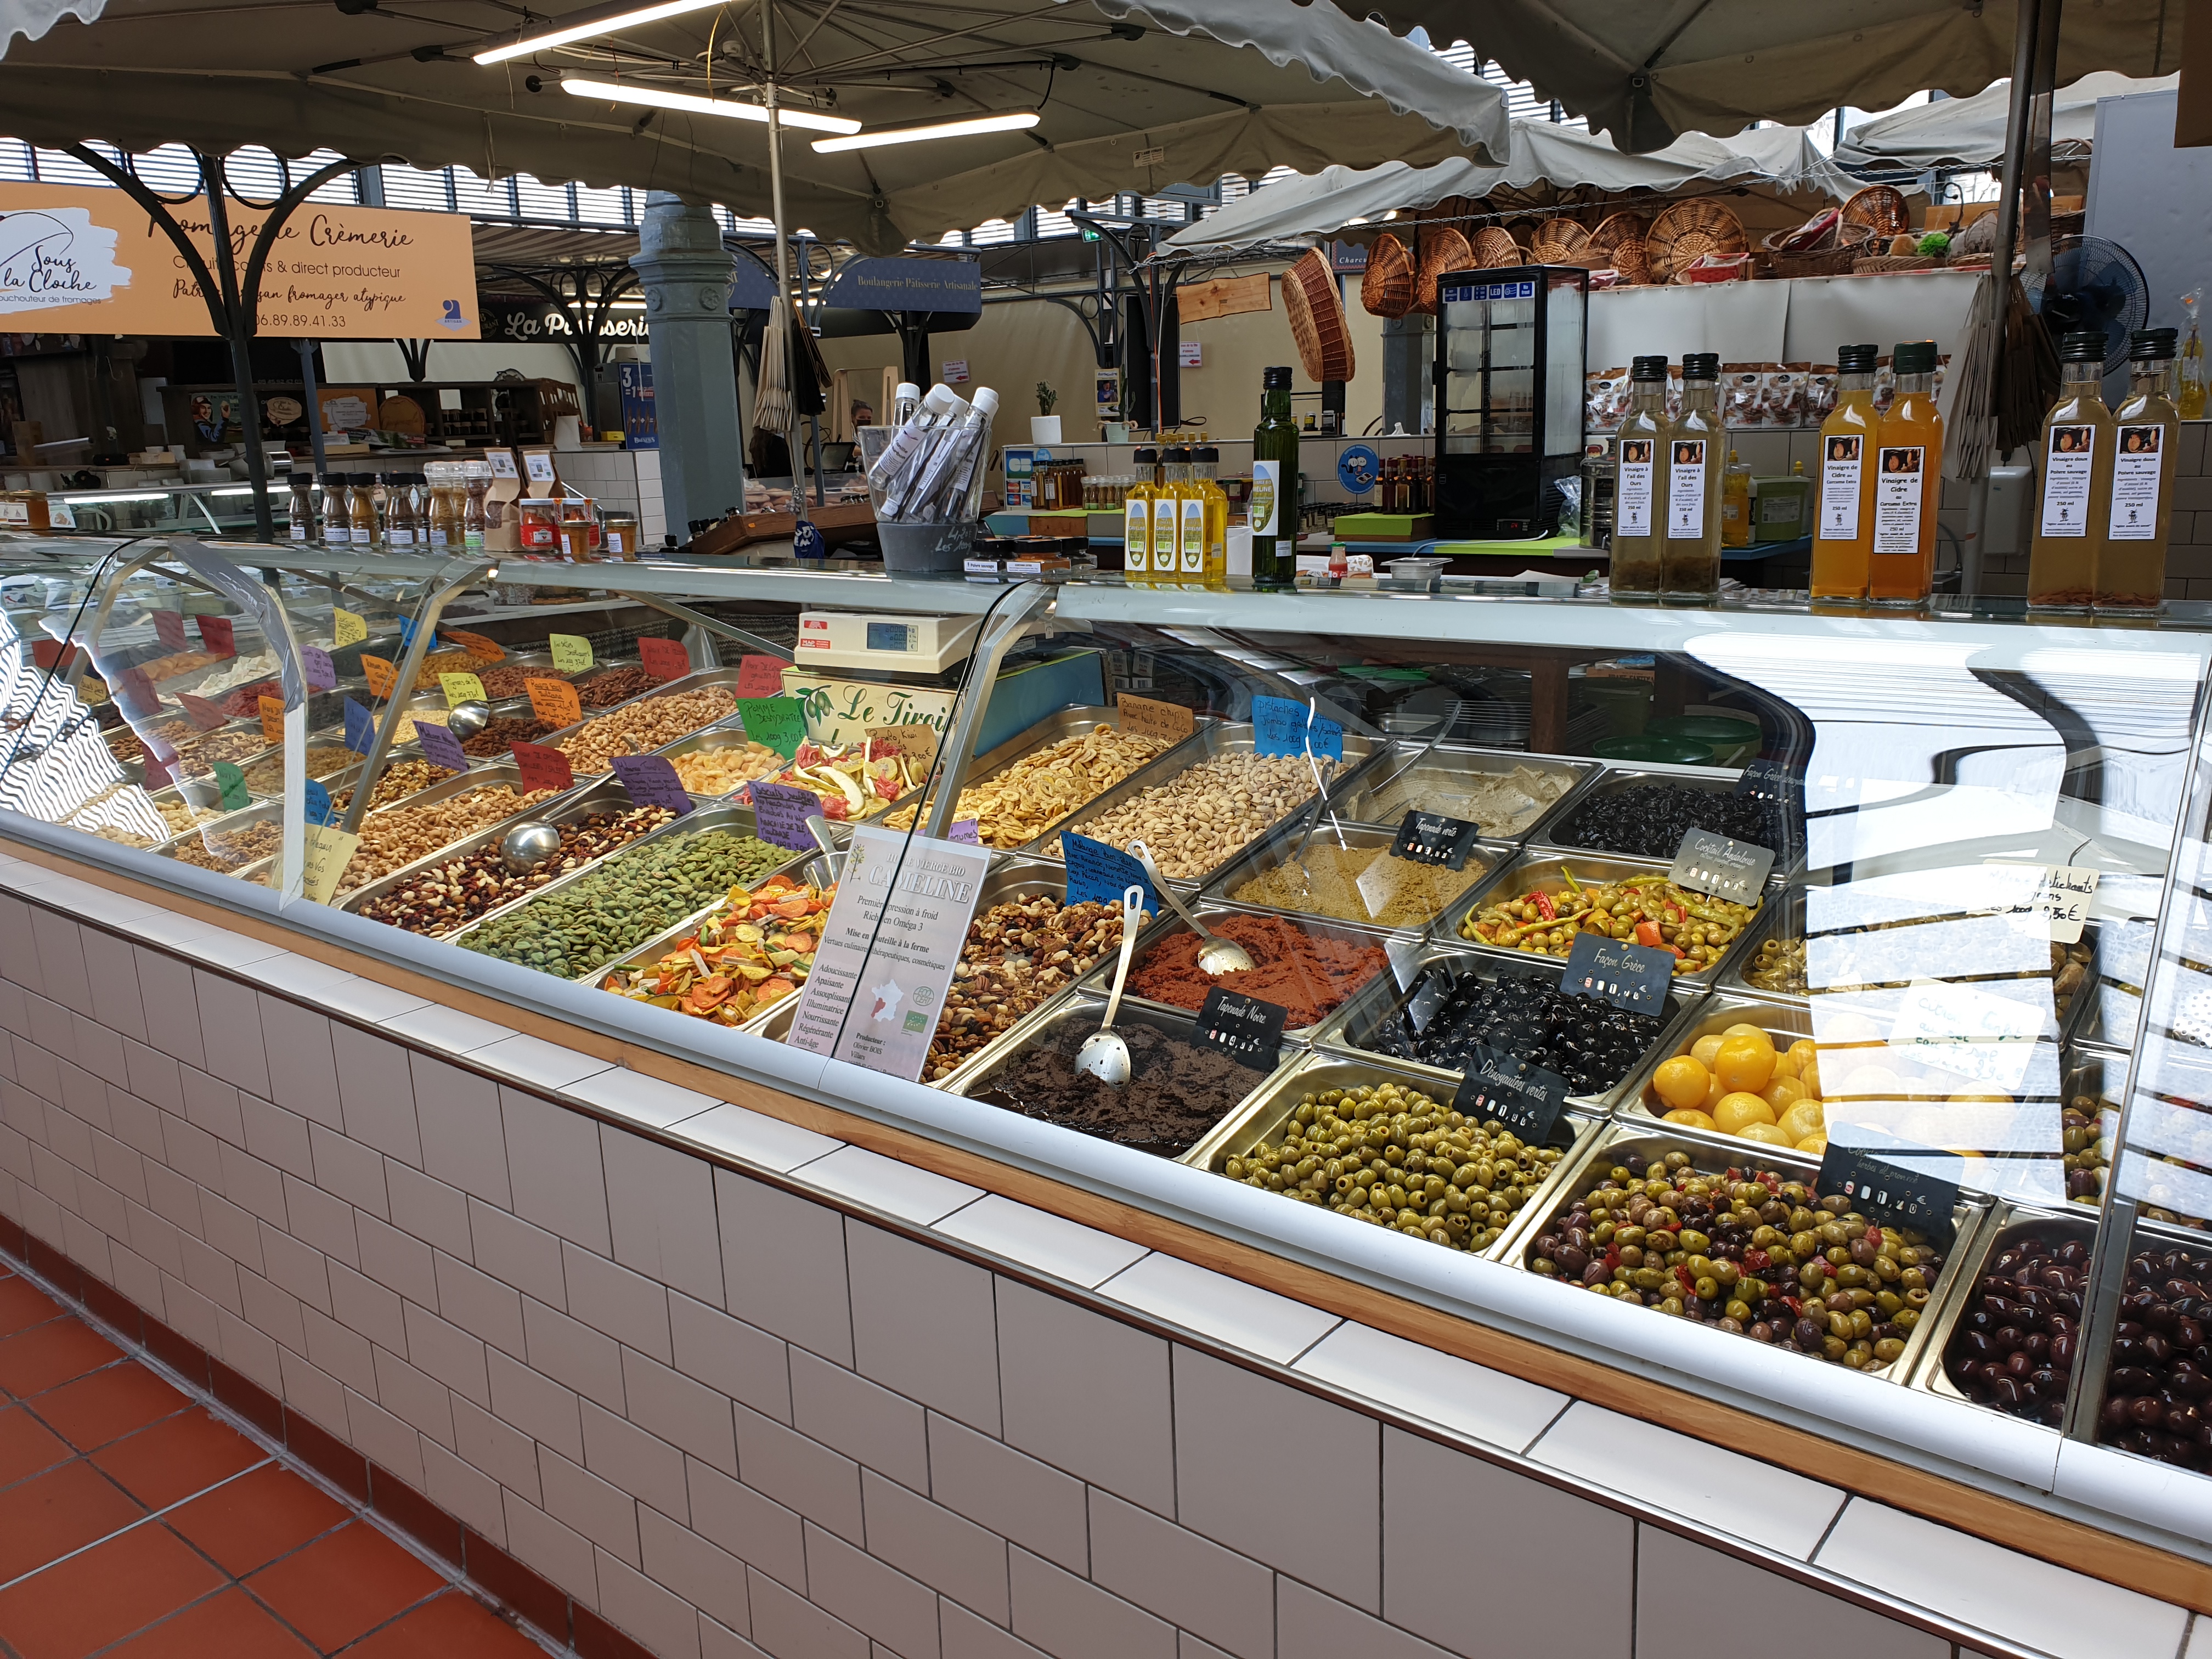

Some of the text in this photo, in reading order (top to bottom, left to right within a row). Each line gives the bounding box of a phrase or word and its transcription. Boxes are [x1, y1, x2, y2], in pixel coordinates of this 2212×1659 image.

[311, 214, 414, 249] Crèmerie
[31, 245, 76, 273] Sous
[278, 261, 400, 278] & direct producteur
[4, 268, 97, 292] la Cloche
[857, 275, 904, 289] Boulangerie
[944, 279, 978, 291] Artisanale
[61, 296, 101, 306] fromages
[288, 285, 348, 309] fromager
[354, 287, 406, 311] atypique
[505, 312, 540, 341] La
[623, 368, 631, 387] 3
[838, 685, 950, 732] Le Tiroi
[1121, 697, 1184, 721] Banane chips
[1160, 719, 1169, 729] de
[1415, 818, 1458, 837] Tapenade verte
[1695, 838, 1756, 866] Cocktail Andalouse
[916, 859, 966, 877] VIERGE BIO
[869, 865, 972, 904] CAMELINE
[887, 904, 914, 915] pression
[916, 908, 919, 916] à
[922, 909, 939, 920] froid
[893, 917, 917, 931] Oméga
[918, 922, 923, 931] 3
[845, 927, 861, 938] Mise
[898, 939, 902, 947] à
[904, 940, 909, 949] la
[911, 942, 930, 953] ferme
[824, 936, 843, 947] Vertues
[912, 957, 946, 970] cosmétiques
[1594, 947, 1645, 973] Façon Grèce
[819, 963, 857, 979] Adoucissante
[815, 975, 844, 989] Apaisante
[806, 998, 844, 1015] Illuminatrice
[1217, 996, 1267, 1024] Tapenade Noire
[802, 1011, 839, 1026] Nourrissante
[798, 1023, 834, 1039] Régénérante
[856, 1032, 883, 1045] Producteur
[794, 1035, 819, 1049] Anti-âge
[853, 1042, 883, 1055] Olivier BOIS
[851, 1051, 865, 1060] Villars
[1480, 1058, 1548, 1102] Dénoyautées vertes
